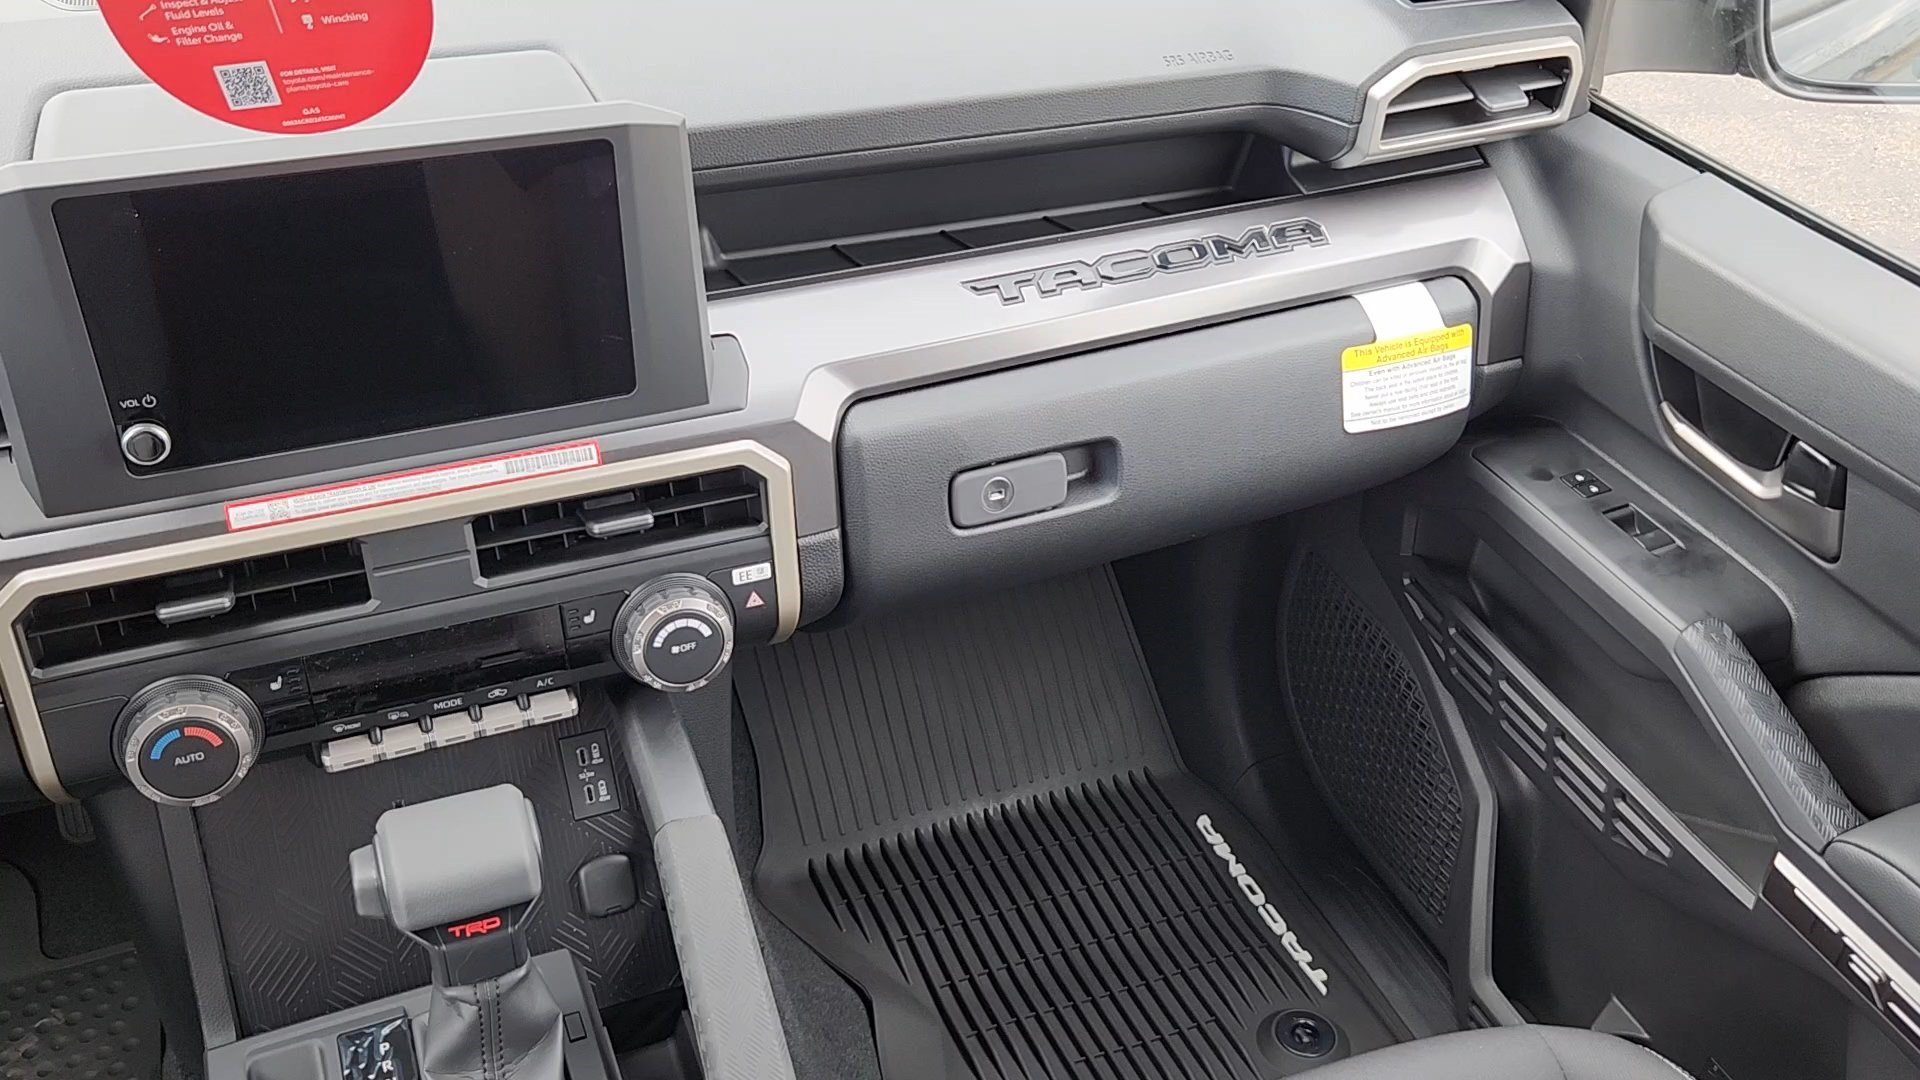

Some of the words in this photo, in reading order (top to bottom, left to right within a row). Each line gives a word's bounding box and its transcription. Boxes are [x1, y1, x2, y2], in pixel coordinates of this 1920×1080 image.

[164, 9, 191, 20] Fluid
[192, 7, 224, 19] Levels
[320, 12, 369, 24] Winching
[171, 24, 207, 36] Engine
[208, 21, 224, 31] Oil
[225, 21, 234, 30] &
[175, 36, 201, 46] Filter
[203, 32, 243, 43] Change
[1162, 54, 1185, 67] SRS
[1187, 49, 1233, 64] AIRBAG
[302, 107, 320, 115] GAS
[960, 217, 1332, 307] TACOMA
[1354, 349, 1372, 358] This
[1374, 343, 1403, 354] Vehicle
[1405, 340, 1412, 348] is
[1414, 332, 1450, 347] Equipped
[1451, 328, 1465, 337] with
[1376, 349, 1416, 363] Advanced
[1417, 346, 1428, 355] Air
[1430, 342, 1449, 354] Bags
[1368, 369, 1386, 377] Even
[1402, 359, 1432, 370] Advanced
[119, 398, 140, 408] VOL
[680, 641, 697, 652] OFF
[536, 676, 554, 688] A/C
[433, 697, 463, 711] MODE
[174, 751, 205, 767] AUTO
[1196, 813, 1328, 996] TACOMA
[448, 915, 501, 938] TRD
[379, 1041, 390, 1056] P
[381, 1059, 394, 1073] R
